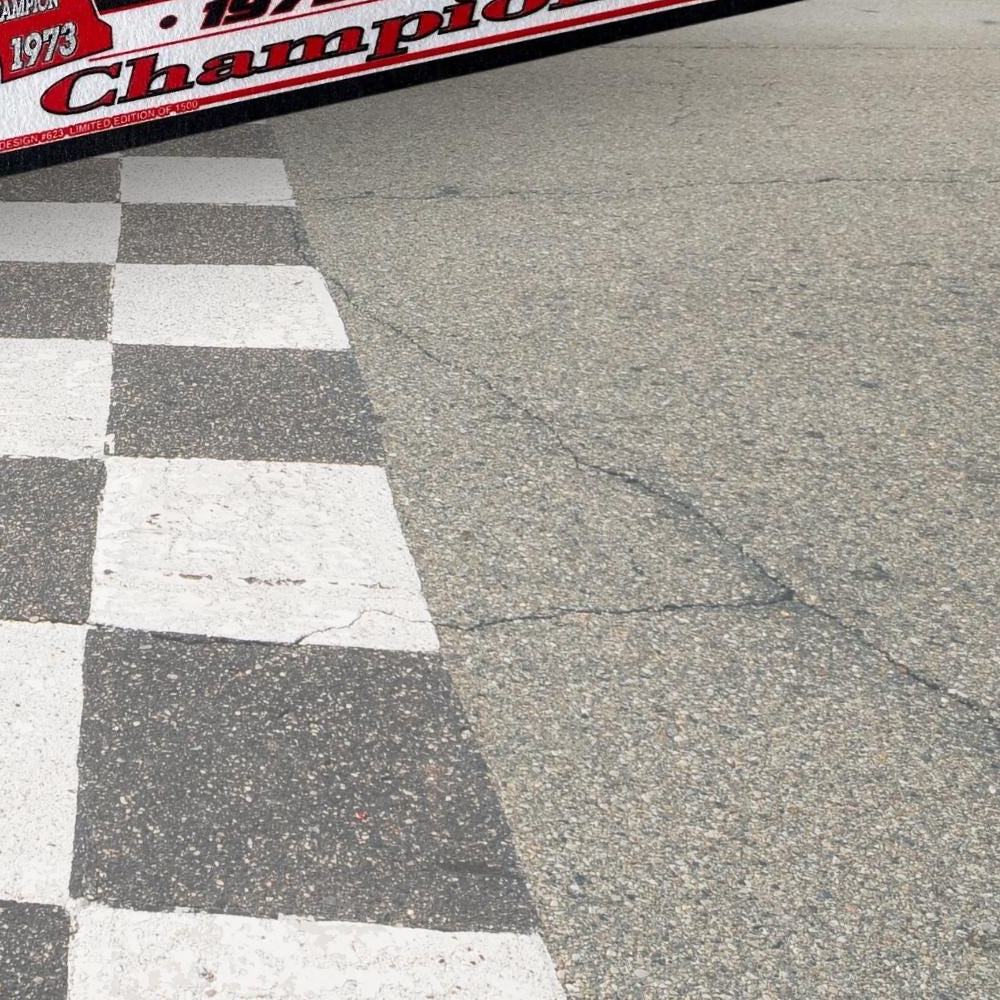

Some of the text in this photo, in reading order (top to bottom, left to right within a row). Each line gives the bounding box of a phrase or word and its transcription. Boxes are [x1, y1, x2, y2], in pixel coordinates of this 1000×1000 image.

[10, 21, 79, 72] 1973
[41, 128, 65, 143] #623
[69, 99, 199, 136] LIMITED EDITION OF 1500
